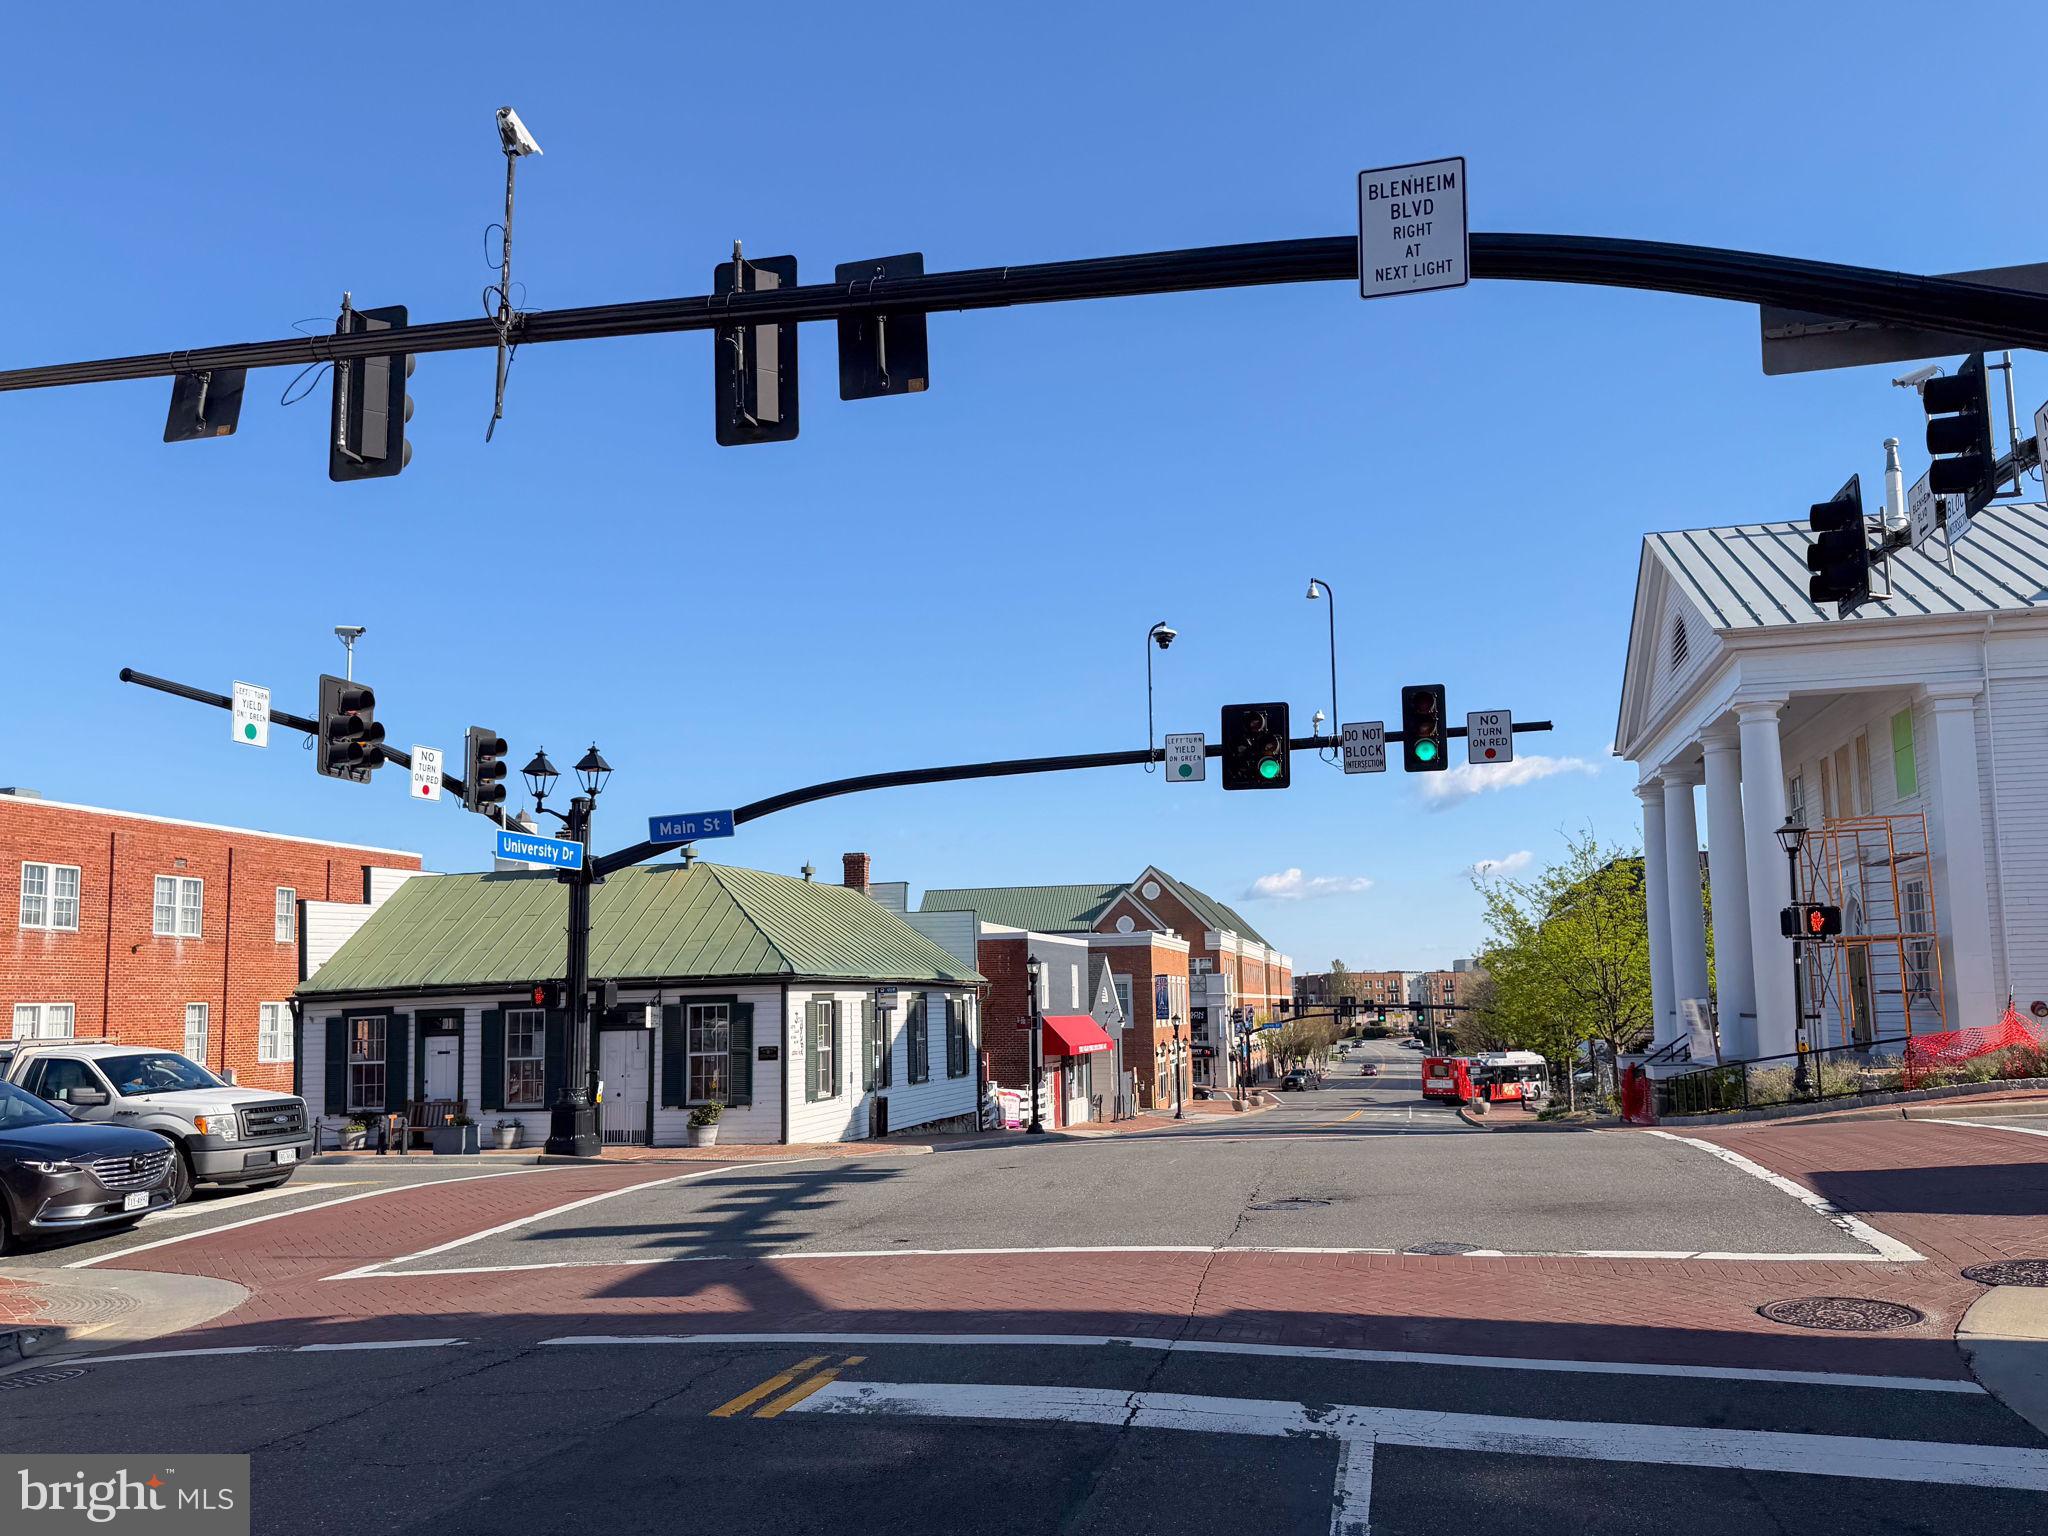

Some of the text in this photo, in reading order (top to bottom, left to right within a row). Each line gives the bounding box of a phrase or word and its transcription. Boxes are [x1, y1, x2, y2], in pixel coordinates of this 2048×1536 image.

[1369, 172, 1455, 200] BLENHEIM
[1391, 199, 1434, 220] BLVD
[1393, 222, 1432, 240] RIGHT
[1405, 243, 1421, 258] AT
[1375, 259, 1453, 282] NEXT LIGHT
[242, 699, 262, 711] YIELD
[249, 712, 266, 722] GREEN
[1480, 715, 1499, 725] NO
[1344, 728, 1381, 741] DO NOT
[1477, 727, 1502, 736] TURN
[1472, 737, 1508, 747] ON RED
[1174, 745, 1196, 754] YIELD
[1345, 744, 1383, 758] BLOCK
[421, 750, 435, 762] NO
[1180, 754, 1202, 762] GREEN
[418, 763, 436, 773] TURN
[1346, 759, 1384, 769] INTERSECTION
[414, 773, 439, 785] ON RED
[659, 818, 721, 836] Main St
[503, 837, 574, 861] University Dr
